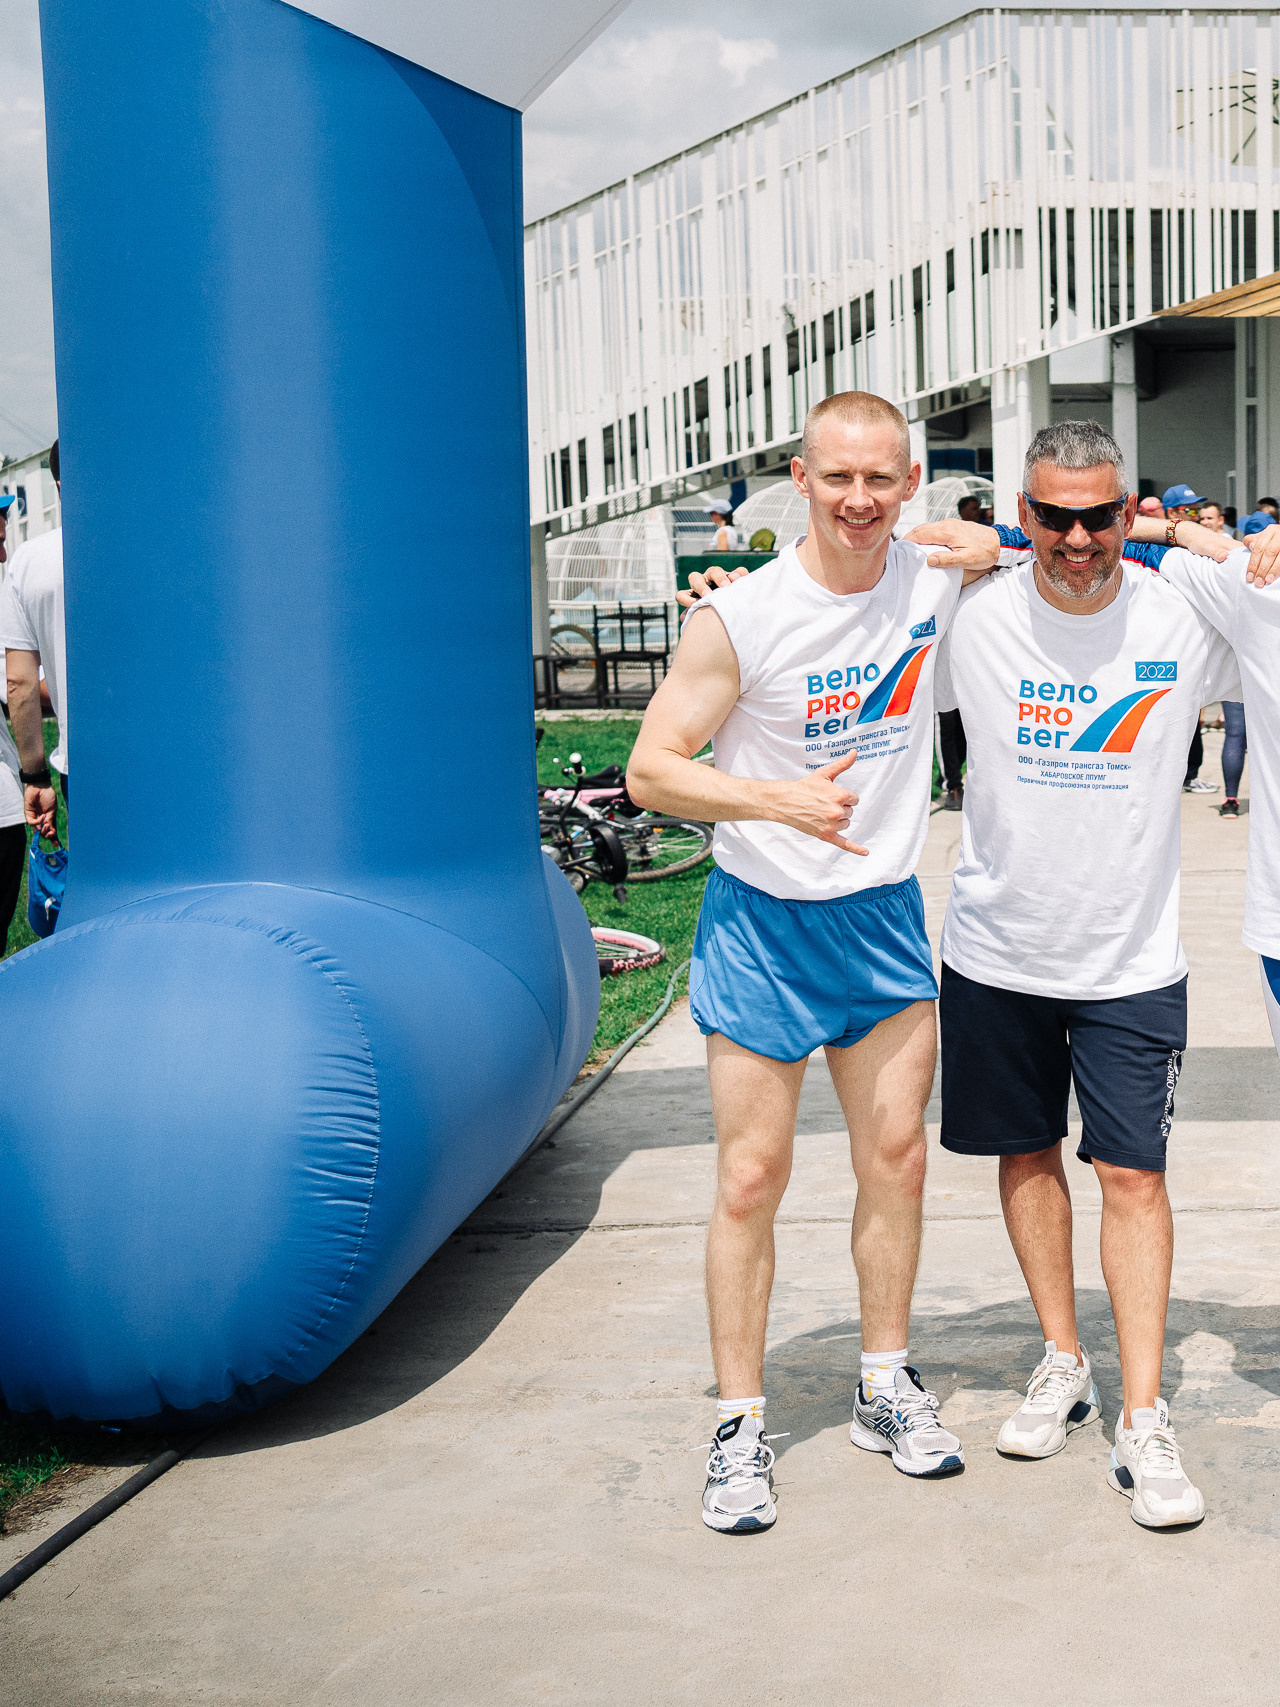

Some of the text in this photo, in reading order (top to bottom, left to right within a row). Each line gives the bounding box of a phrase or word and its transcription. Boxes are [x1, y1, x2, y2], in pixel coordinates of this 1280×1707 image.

[1138, 664, 1175, 679] 2022
[807, 691, 861, 719] PRO
[1018, 702, 1073, 726] PRO
[805, 743, 822, 752] ООО
[859, 729, 888, 741] трансгаз
[1018, 755, 1131, 770] ООО «Газпром трансгаз Томск»
[1017, 775, 1048, 786] Первичная
[1048, 780, 1091, 789] профсоюзная
[1040, 770, 1083, 780] ХАБАРОВСКОЕ
